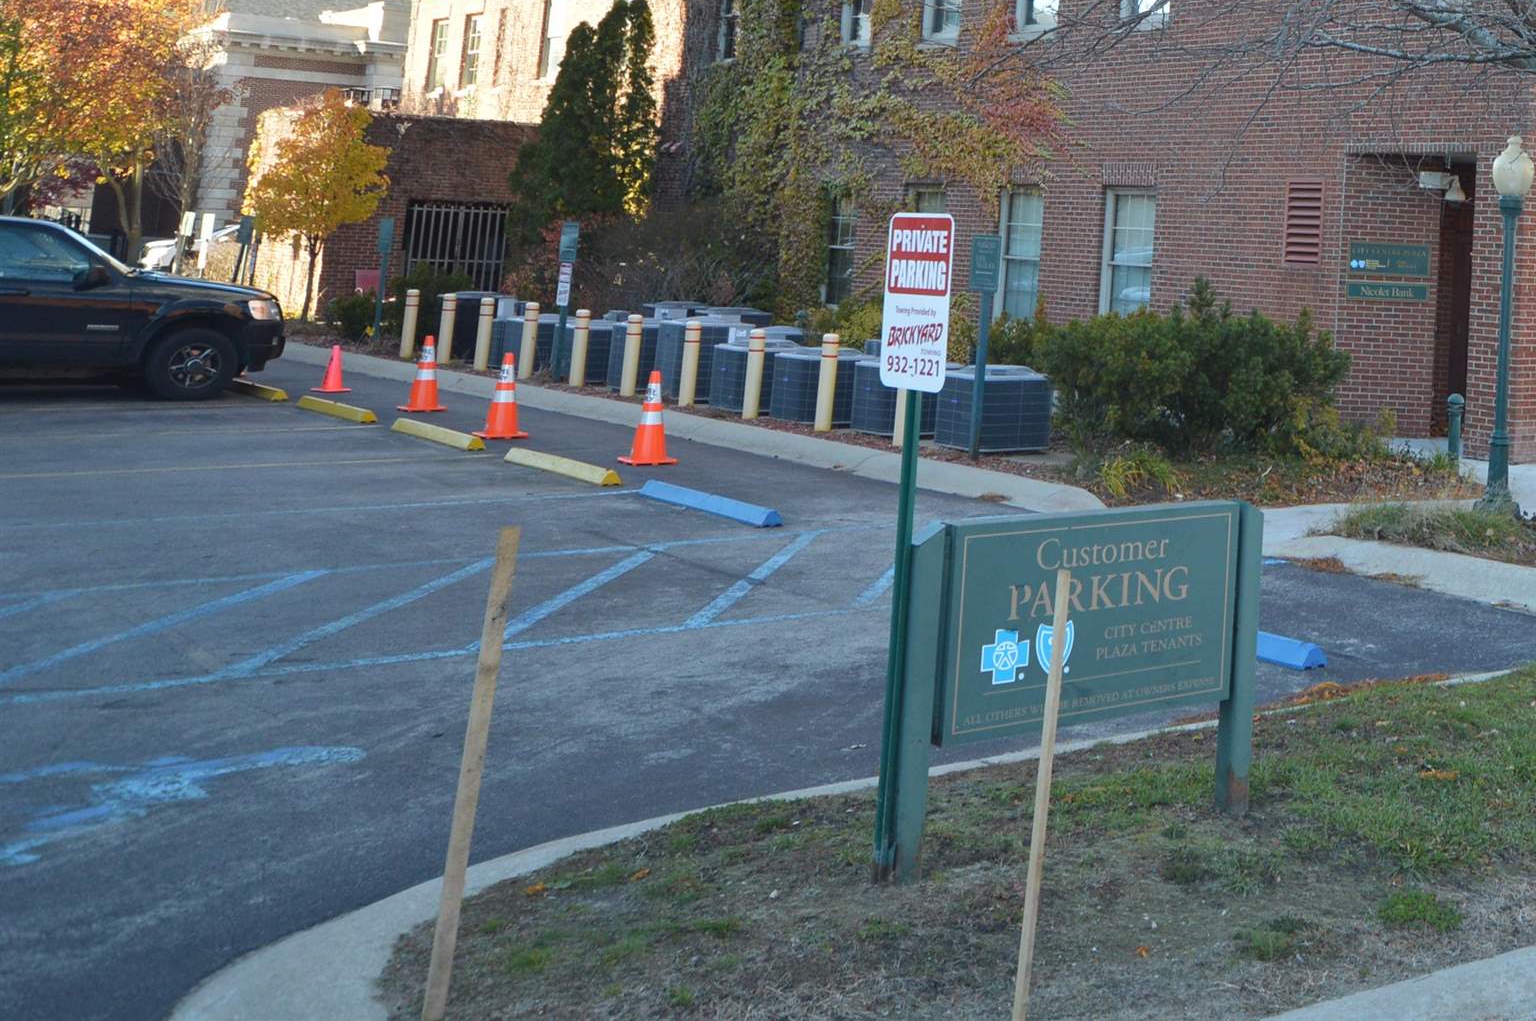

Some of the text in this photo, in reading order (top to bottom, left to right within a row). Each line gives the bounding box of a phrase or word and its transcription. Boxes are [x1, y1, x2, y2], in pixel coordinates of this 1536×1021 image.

[892, 230, 948, 254] PRIVATE
[890, 259, 947, 291] PARKING
[1391, 287, 1415, 298] Bank
[887, 322, 944, 347] BRICKYARD
[887, 355, 940, 377] 932-1221
[1036, 537, 1169, 570] Customer
[1007, 565, 1190, 622] PARKING
[1104, 616, 1193, 640] CITY CENTRE
[1096, 634, 1203, 660] PLAZA TENANTS
[963, 714, 984, 726] ALL
[985, 706, 1027, 723] OTHERS
[1071, 690, 1121, 708] REMOVED
